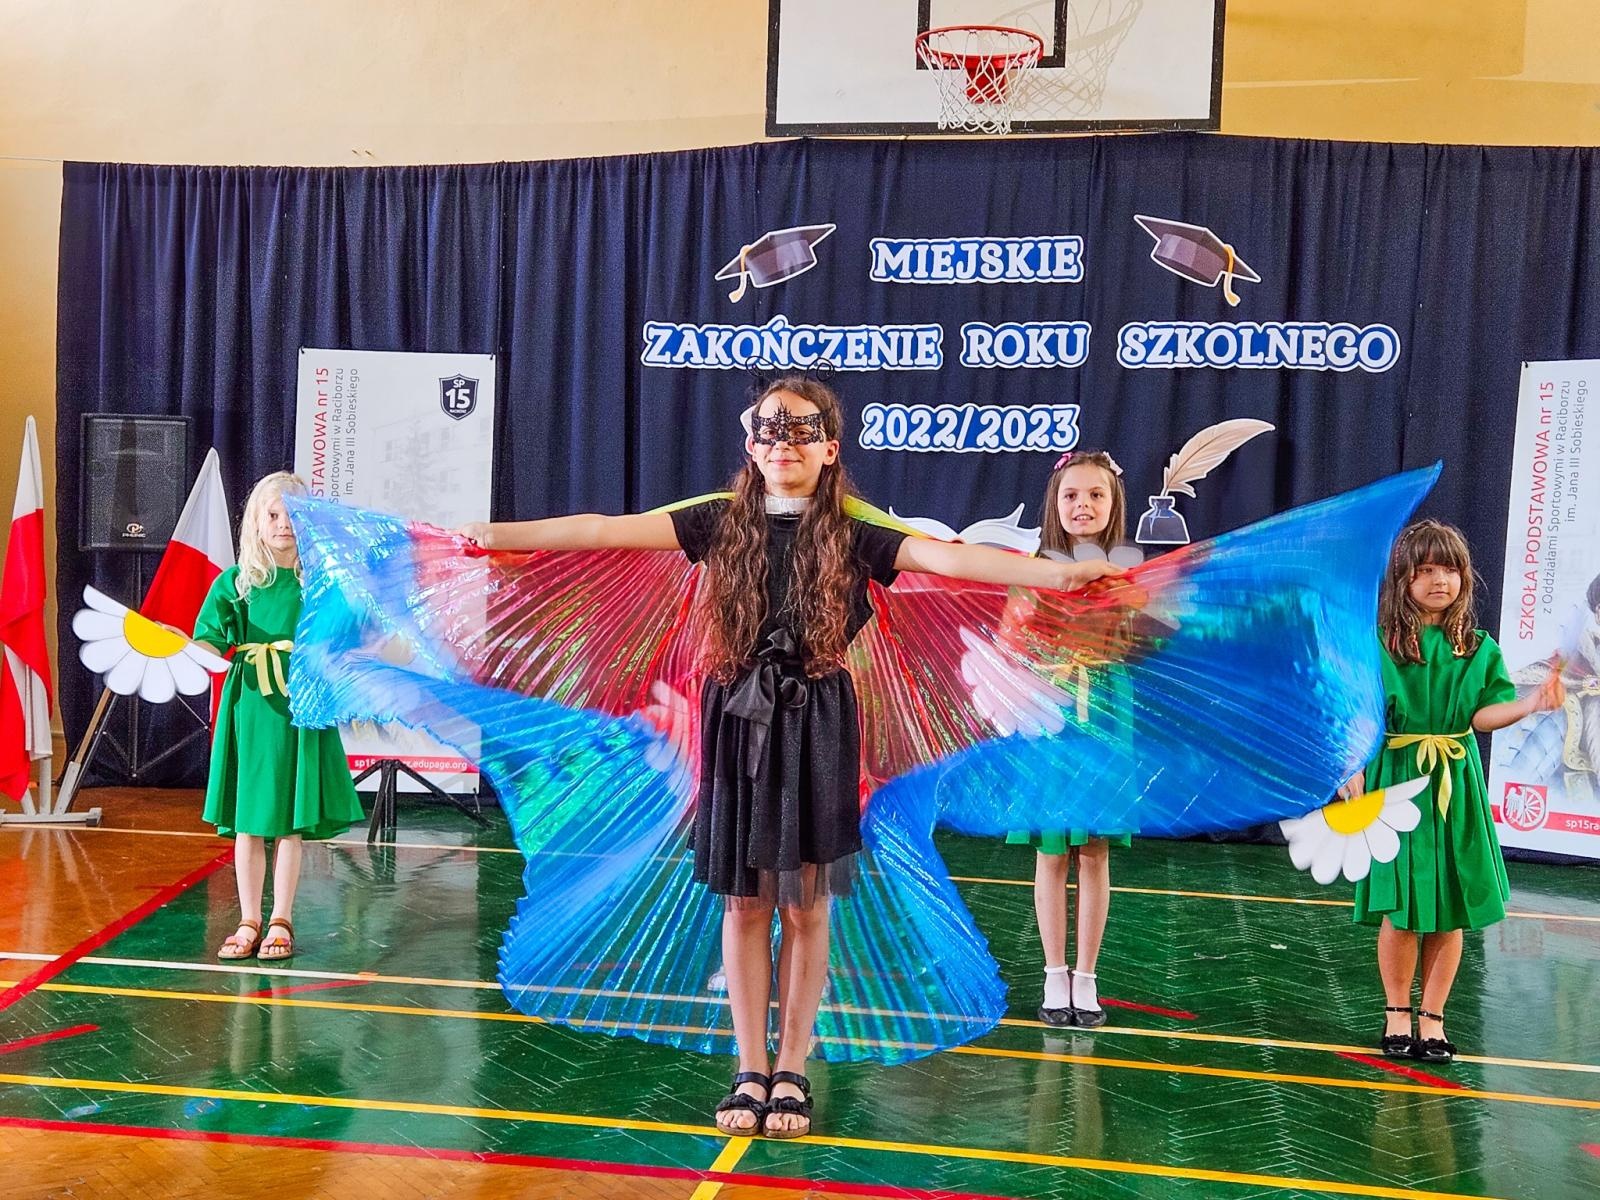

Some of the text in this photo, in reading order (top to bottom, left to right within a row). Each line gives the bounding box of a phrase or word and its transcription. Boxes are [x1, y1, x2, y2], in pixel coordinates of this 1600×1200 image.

[872, 239, 1081, 282] MIEJSKIE
[452, 378, 466, 388] SP
[643, 316, 1397, 370] ZAKOŃCZENIE ROKU SZKOLNEGO
[311, 367, 329, 497] STAWOWA nr 15
[329, 367, 344, 504] Sportowymi w Raciborzu
[343, 367, 360, 495] im. Jana III Sobieskiego
[445, 388, 471, 409] 15
[862, 405, 1079, 449] 2022/2023
[1564, 380, 1588, 522] im. Jana III Sobieskiego
[1519, 381, 1554, 641] SZKOŁA PODSTAWOWA nr 15
[1541, 380, 1571, 615] z Oddziałami Sportowymi w Raciborzu
[1565, 819, 1600, 831] sp15ra
